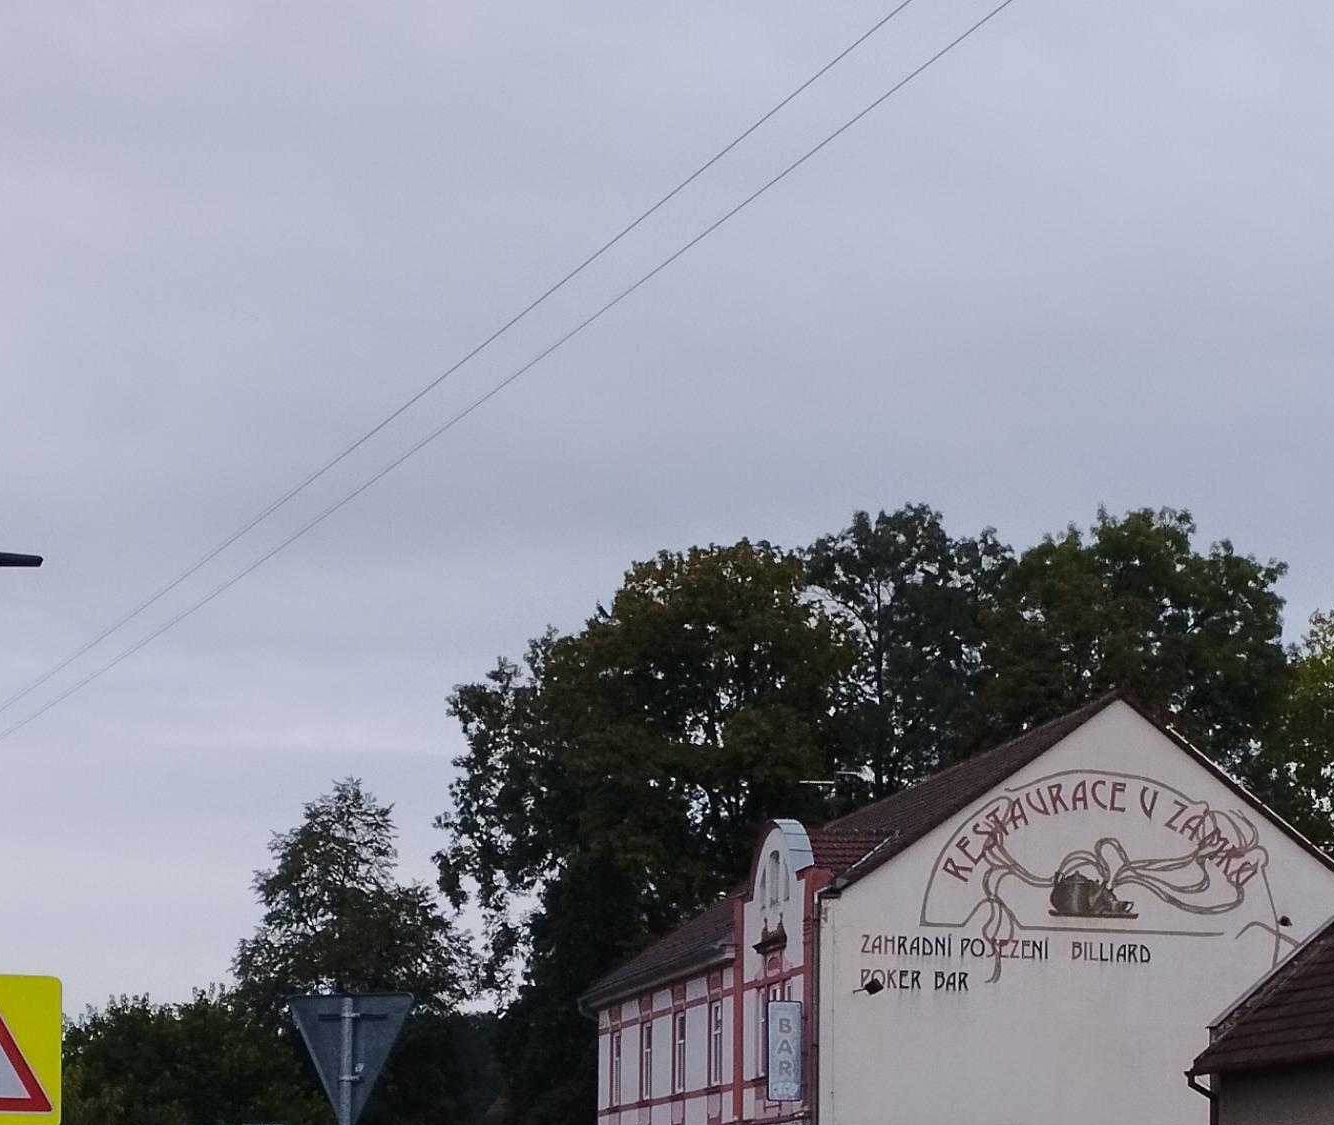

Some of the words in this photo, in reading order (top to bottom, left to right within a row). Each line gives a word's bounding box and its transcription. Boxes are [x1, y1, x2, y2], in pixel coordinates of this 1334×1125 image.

[942, 779, 1127, 882] RESTAURACE
[1139, 785, 1159, 821] U
[860, 933, 952, 957] ZAHRADNÍ
[960, 936, 1049, 960] POSEZENÍ
[1071, 941, 1151, 963] BILLIARD
[860, 968, 922, 990] POKER
[934, 971, 969, 992] BAR
[776, 1017, 793, 1077] BAR
